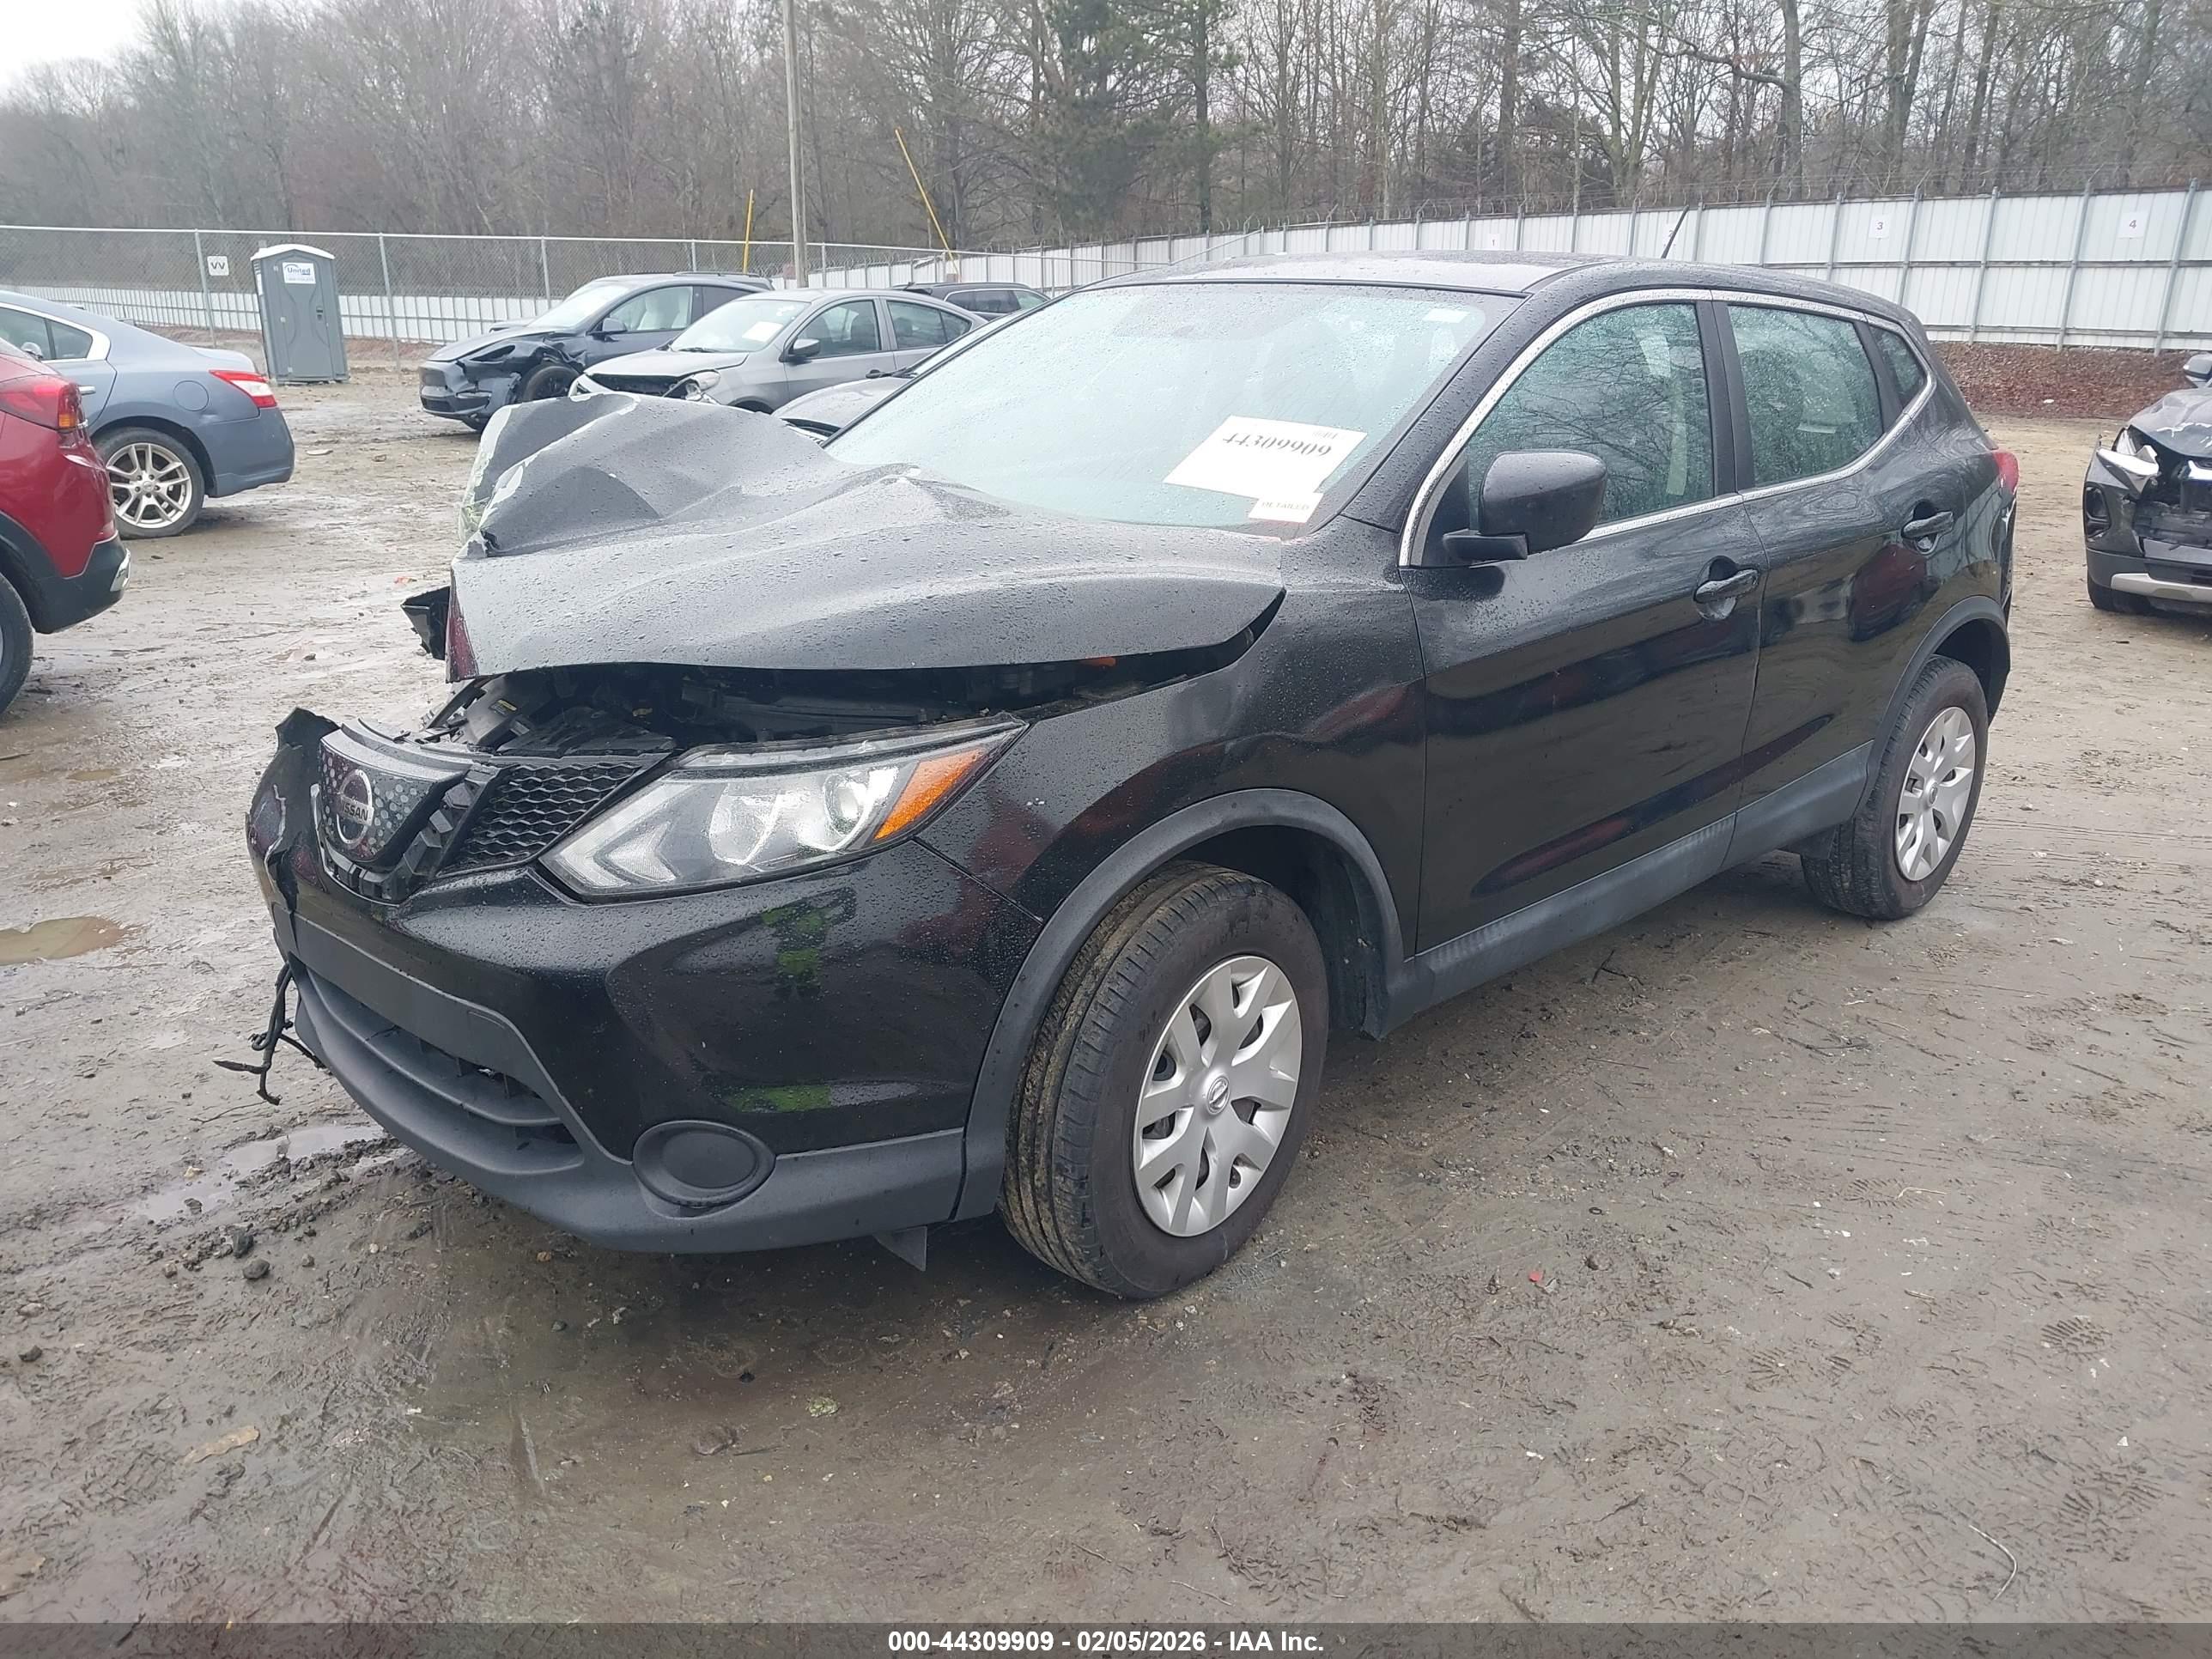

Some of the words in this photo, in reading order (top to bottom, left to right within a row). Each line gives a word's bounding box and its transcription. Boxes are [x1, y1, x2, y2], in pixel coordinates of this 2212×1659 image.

[1877, 222, 1883, 230] 3
[2129, 219, 2136, 228] 4
[1222, 433, 1332, 456] 44309909
